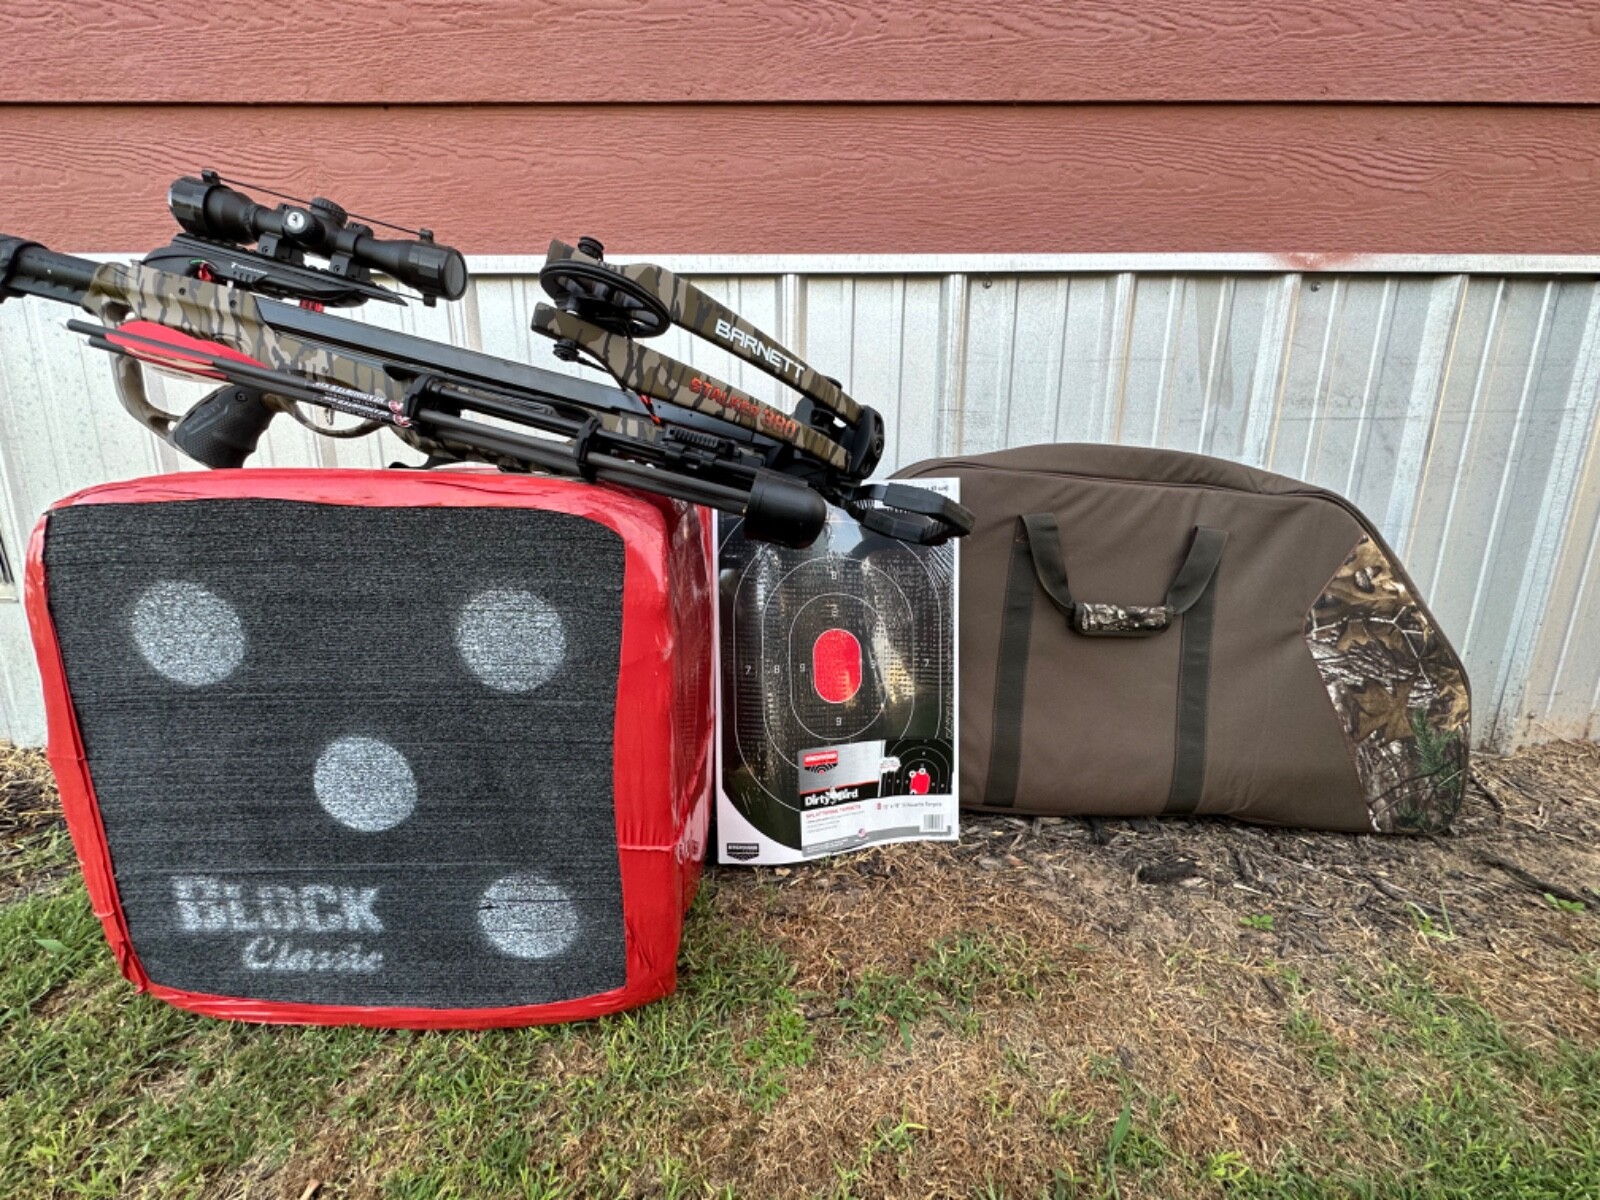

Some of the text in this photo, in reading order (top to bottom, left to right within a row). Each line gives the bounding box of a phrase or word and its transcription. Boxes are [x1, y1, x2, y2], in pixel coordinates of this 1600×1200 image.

[715, 318, 805, 379] BARNETT
[689, 377, 760, 419] STALKER
[804, 792, 832, 807] Dirty
[172, 875, 384, 932] BLOCK
[243, 936, 383, 972] Classic
